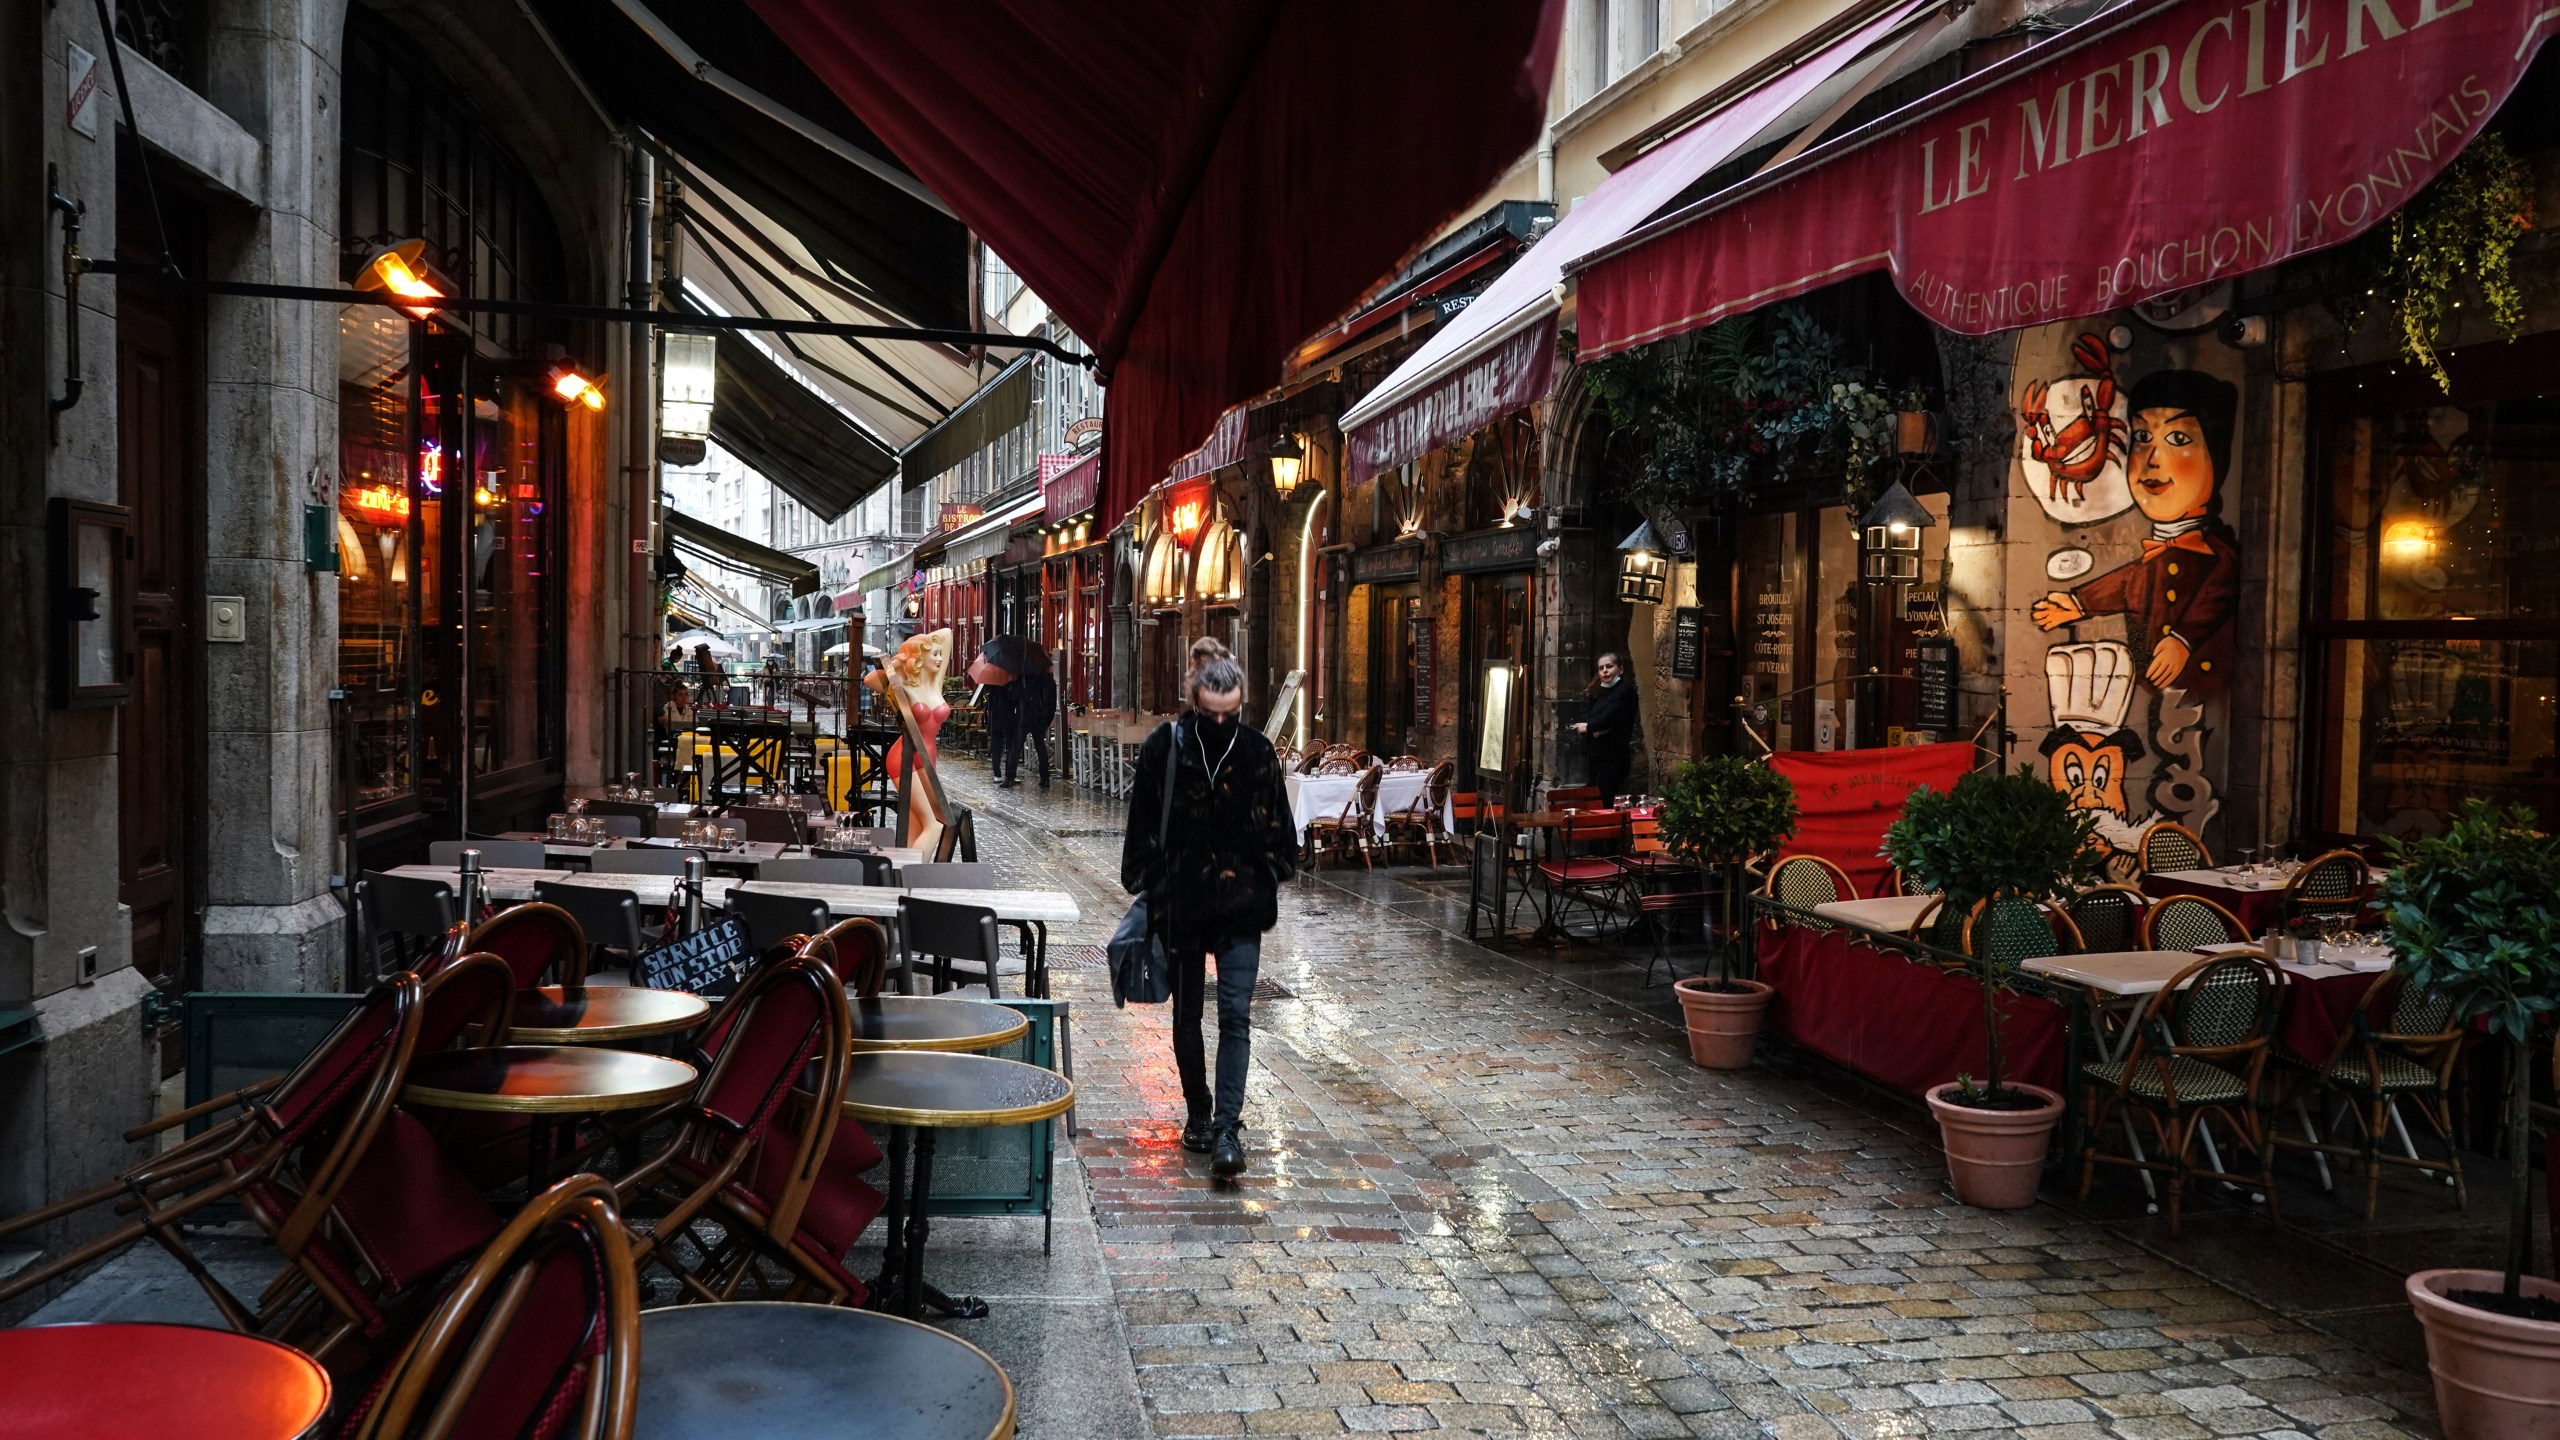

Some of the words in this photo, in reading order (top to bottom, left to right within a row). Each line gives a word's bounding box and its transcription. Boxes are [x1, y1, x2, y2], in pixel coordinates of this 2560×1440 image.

[1919, 117, 1991, 216] LE
[1911, 268, 2070, 325] AUTHENTIQUE
[2097, 215, 2274, 303] BOUCHON
[2295, 74, 2493, 244] LYONNAIS
[1377, 417, 1396, 465] LA
[956, 505, 967, 514] LE
[1675, 532, 1686, 551] 58
[1759, 593, 1792, 606] BROUILLY
[1757, 613, 1766, 625] ST
[1766, 613, 1792, 625] JOSEPH
[1757, 661, 1766, 673] ST
[643, 920, 738, 974] SERVICE
[647, 963, 687, 990] NON
[689, 937, 742, 975] STOP
[689, 963, 728, 991] DAY
